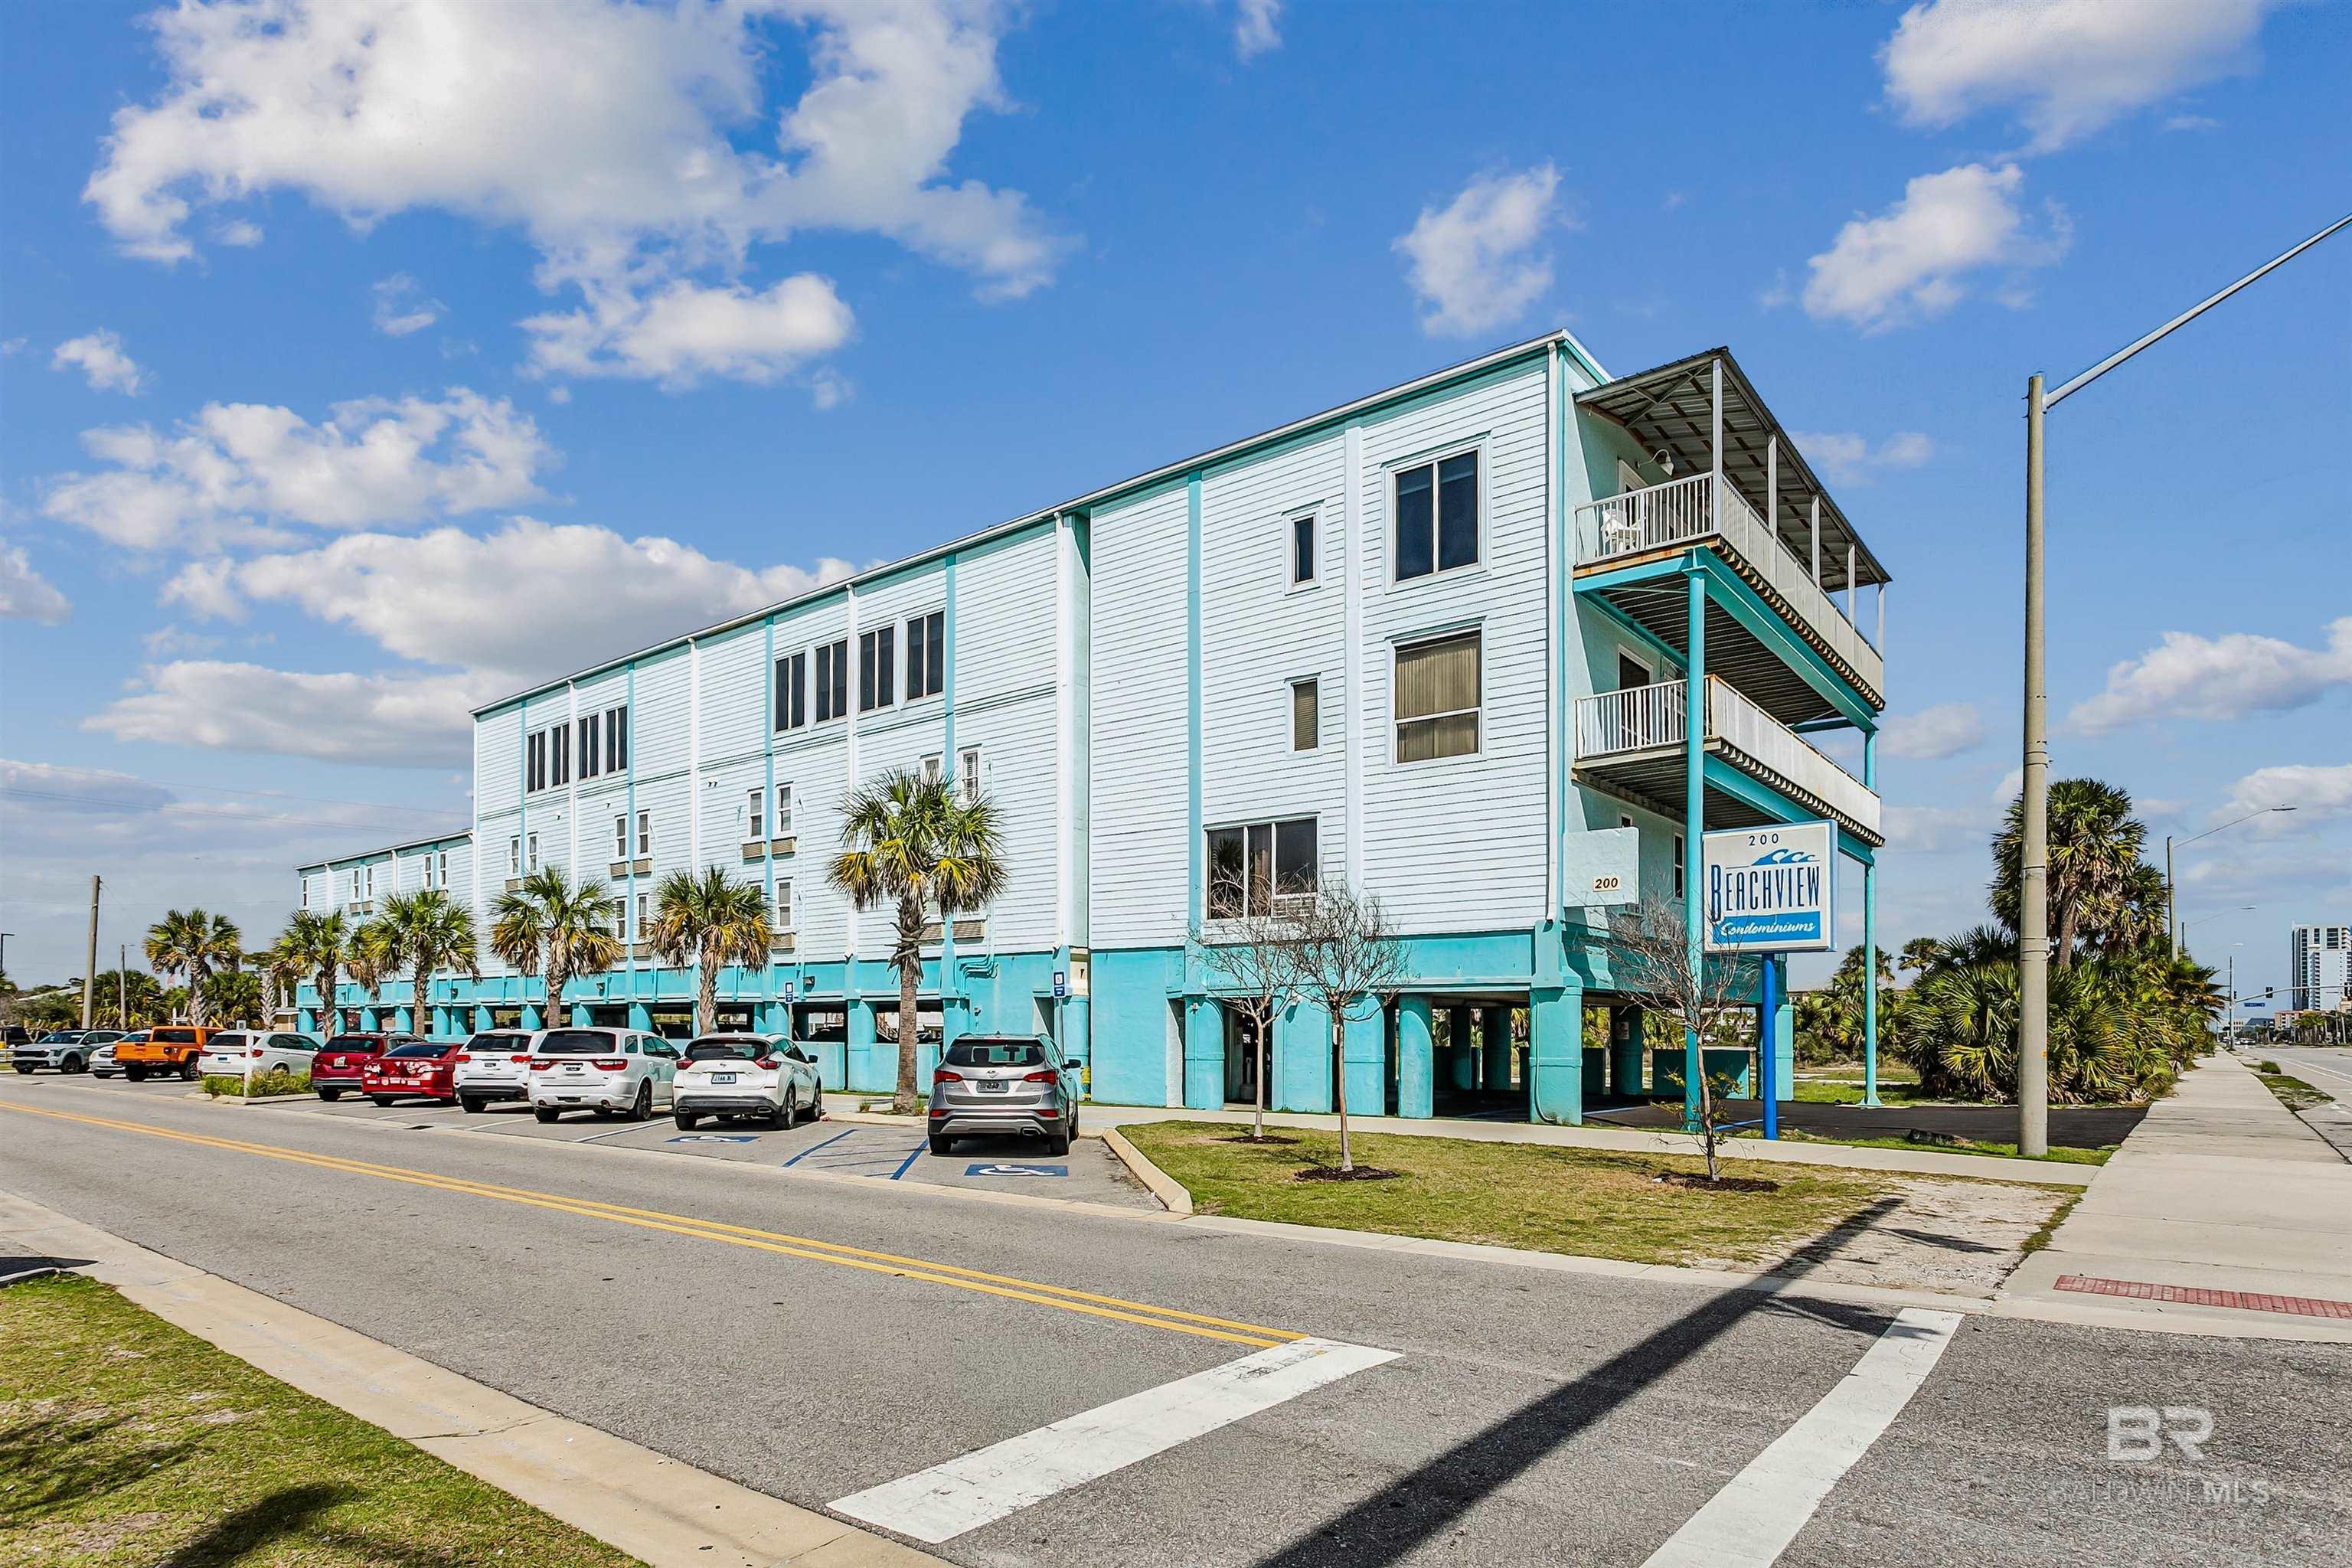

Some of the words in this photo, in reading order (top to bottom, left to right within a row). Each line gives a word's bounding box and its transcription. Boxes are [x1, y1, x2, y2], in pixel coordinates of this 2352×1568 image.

[1749, 833, 1779, 846] 200
[1595, 877, 1618, 889] 200
[1710, 864, 1820, 922] BEACHVIEW
[1720, 921, 1816, 936] Condominiums
